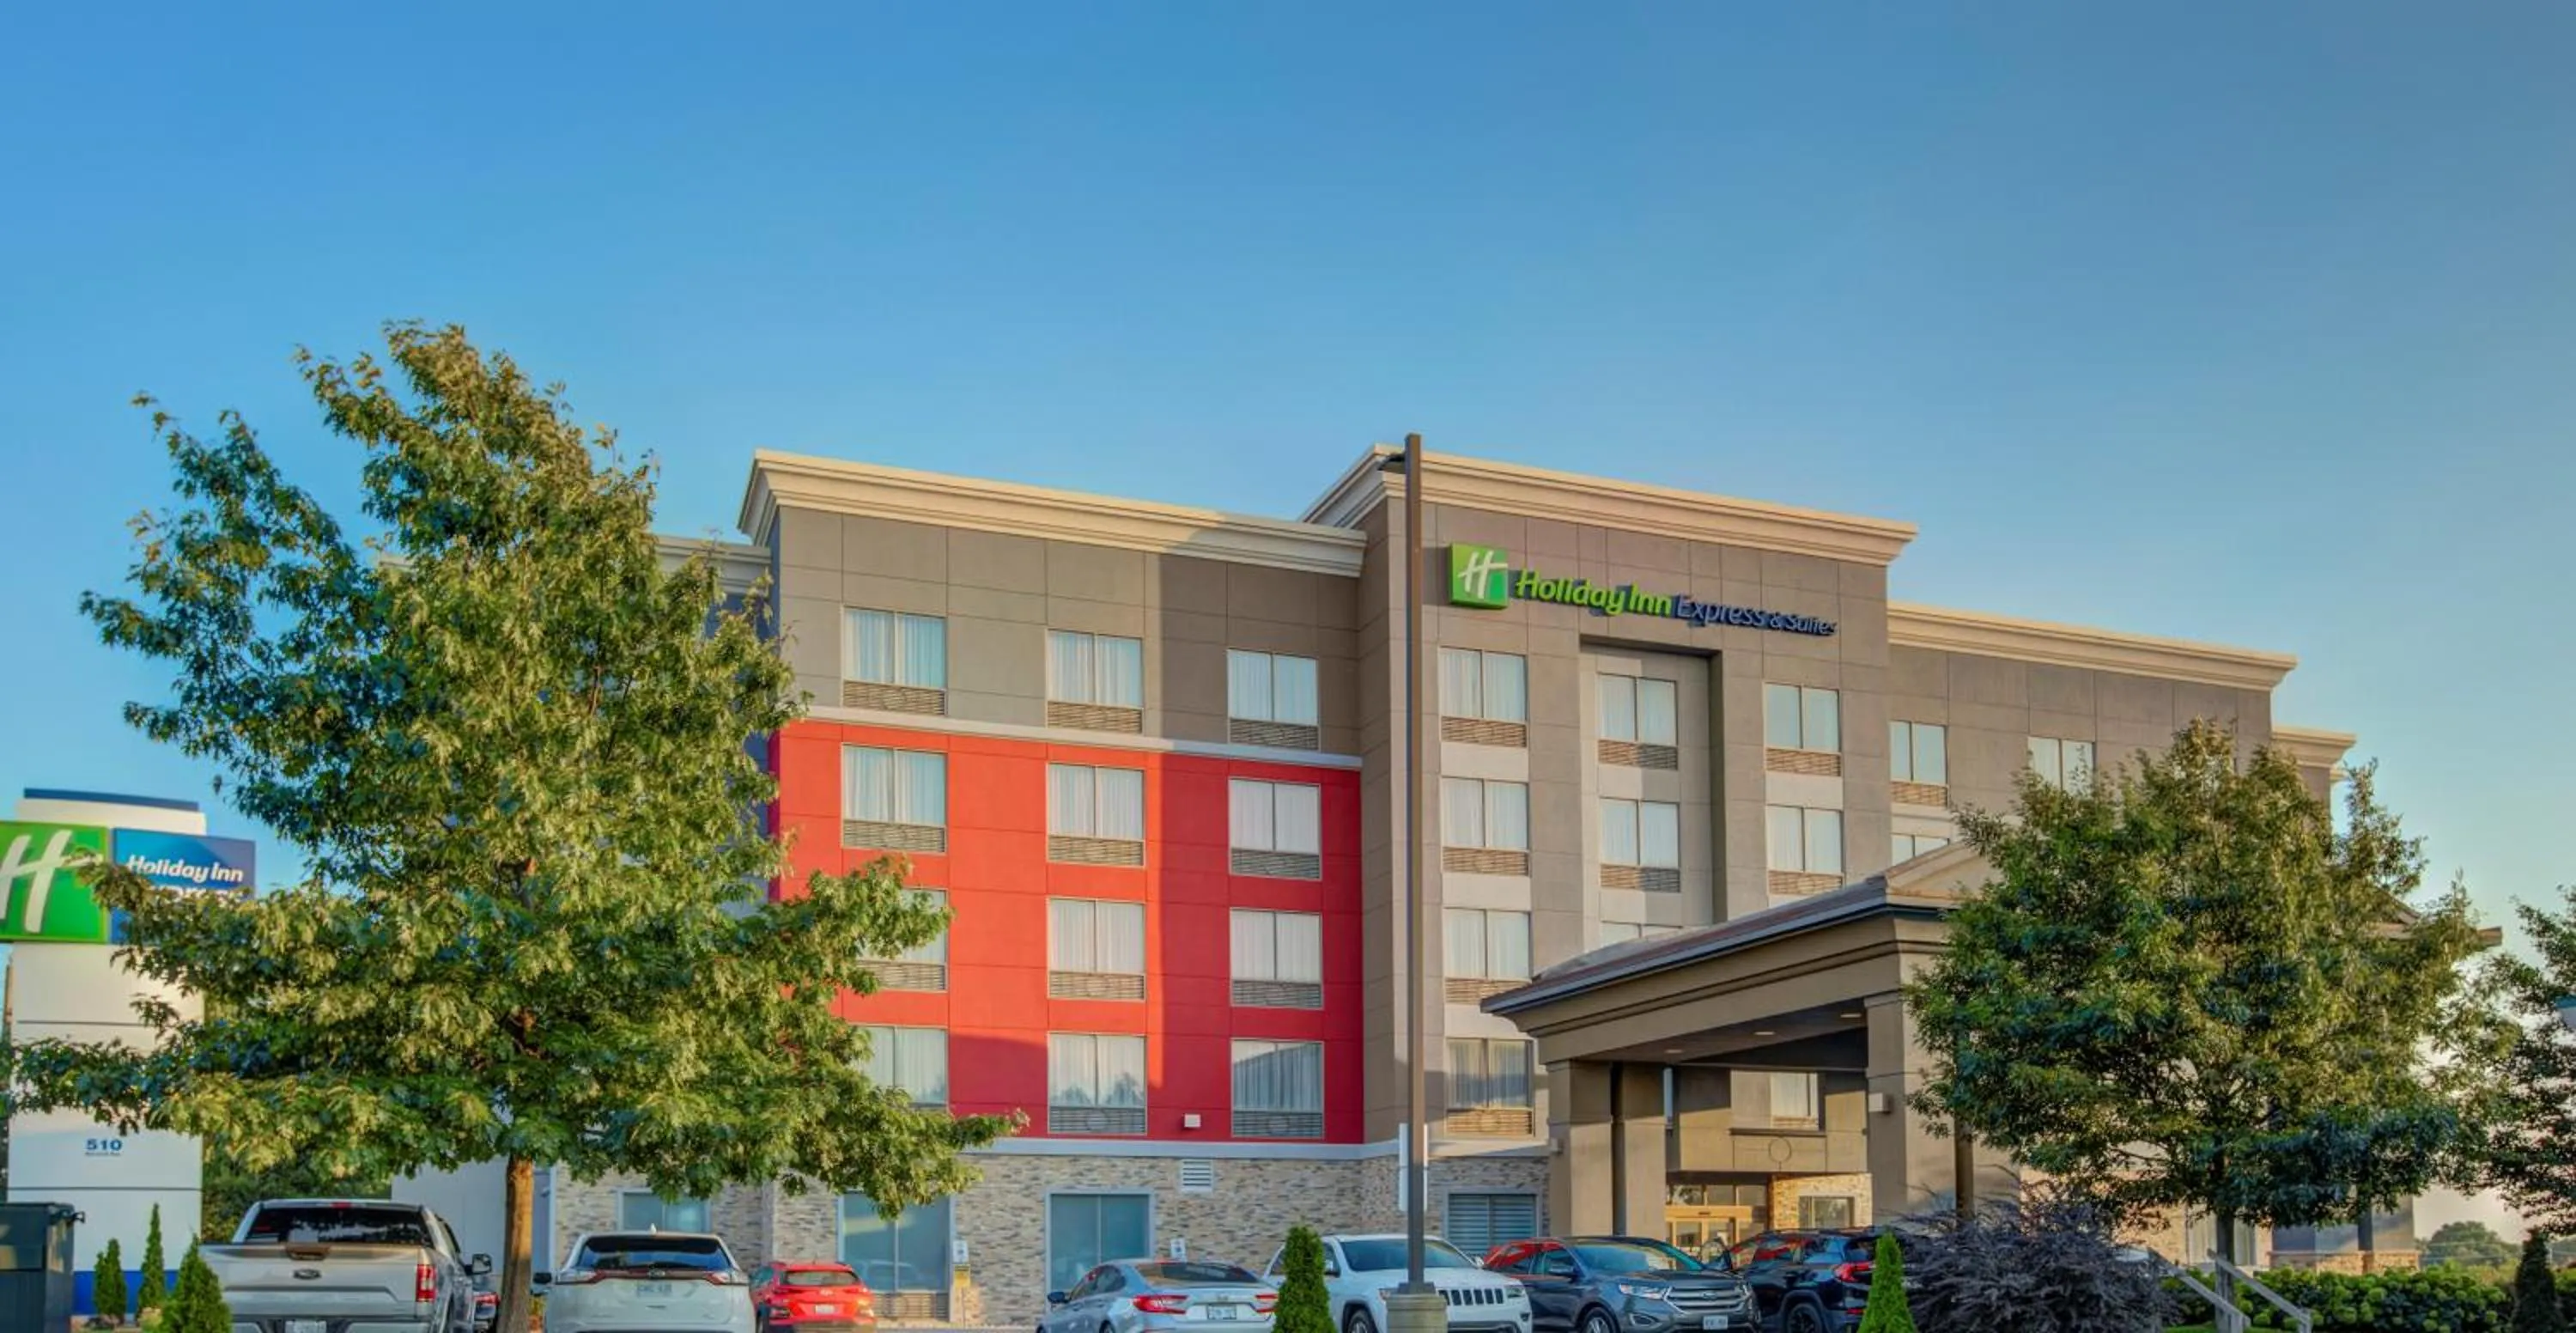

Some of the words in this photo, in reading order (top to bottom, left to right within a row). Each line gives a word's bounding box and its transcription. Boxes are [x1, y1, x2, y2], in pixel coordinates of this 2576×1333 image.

[1516, 569, 1625, 616] Holiday
[1631, 582, 1672, 615] Inn
[1676, 594, 1765, 628] Express
[126, 854, 210, 884] Holiday
[210, 861, 244, 882] Inn
[87, 1139, 122, 1151] 510
